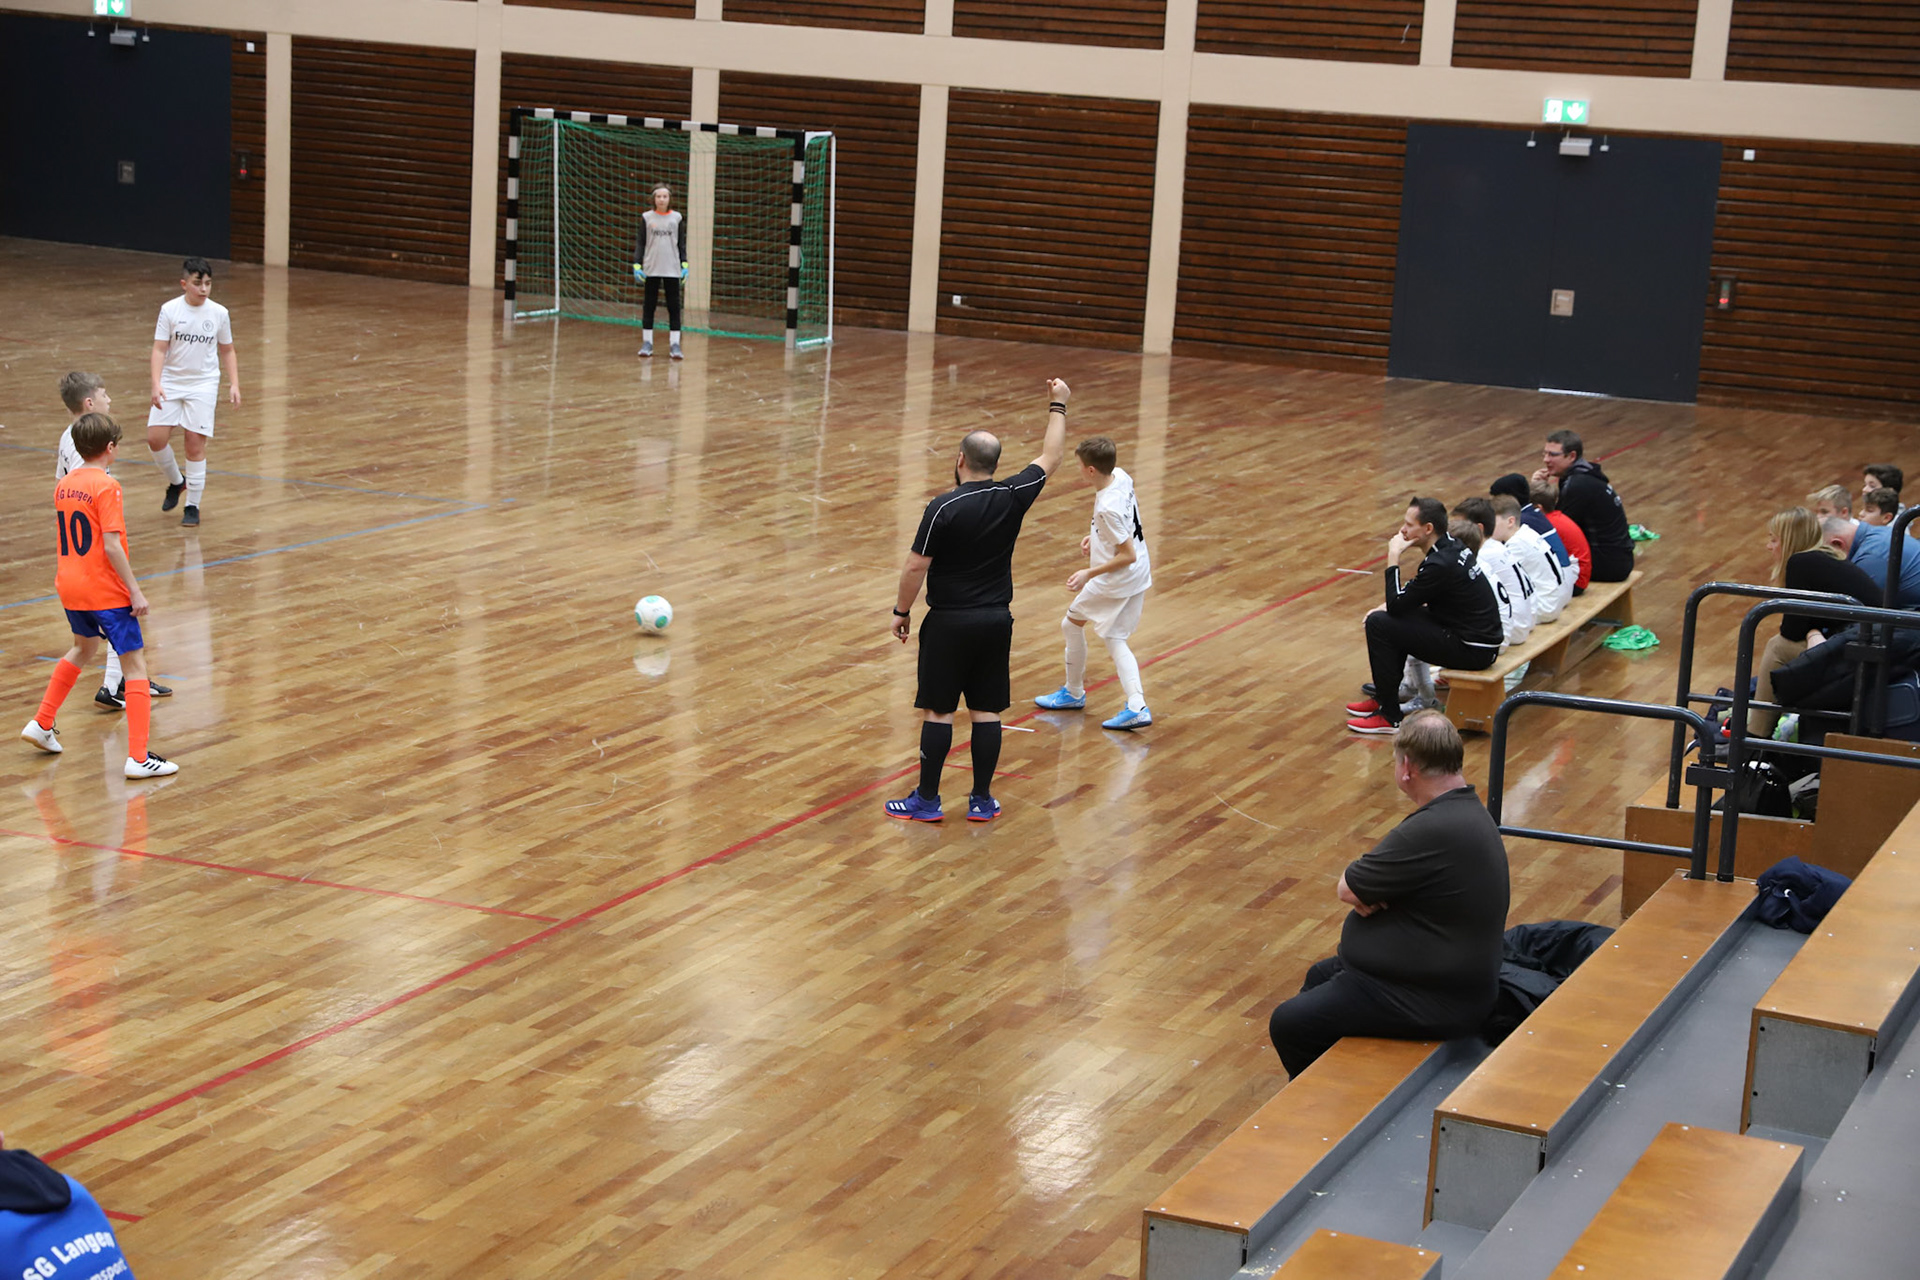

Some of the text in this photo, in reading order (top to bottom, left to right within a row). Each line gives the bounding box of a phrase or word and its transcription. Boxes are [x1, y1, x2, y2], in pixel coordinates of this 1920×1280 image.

[175, 330, 214, 345] Fraport
[66, 488, 94, 505] Langen
[57, 510, 92, 557] 10
[1497, 581, 1513, 618] 9
[50, 1231, 115, 1265] Langen
